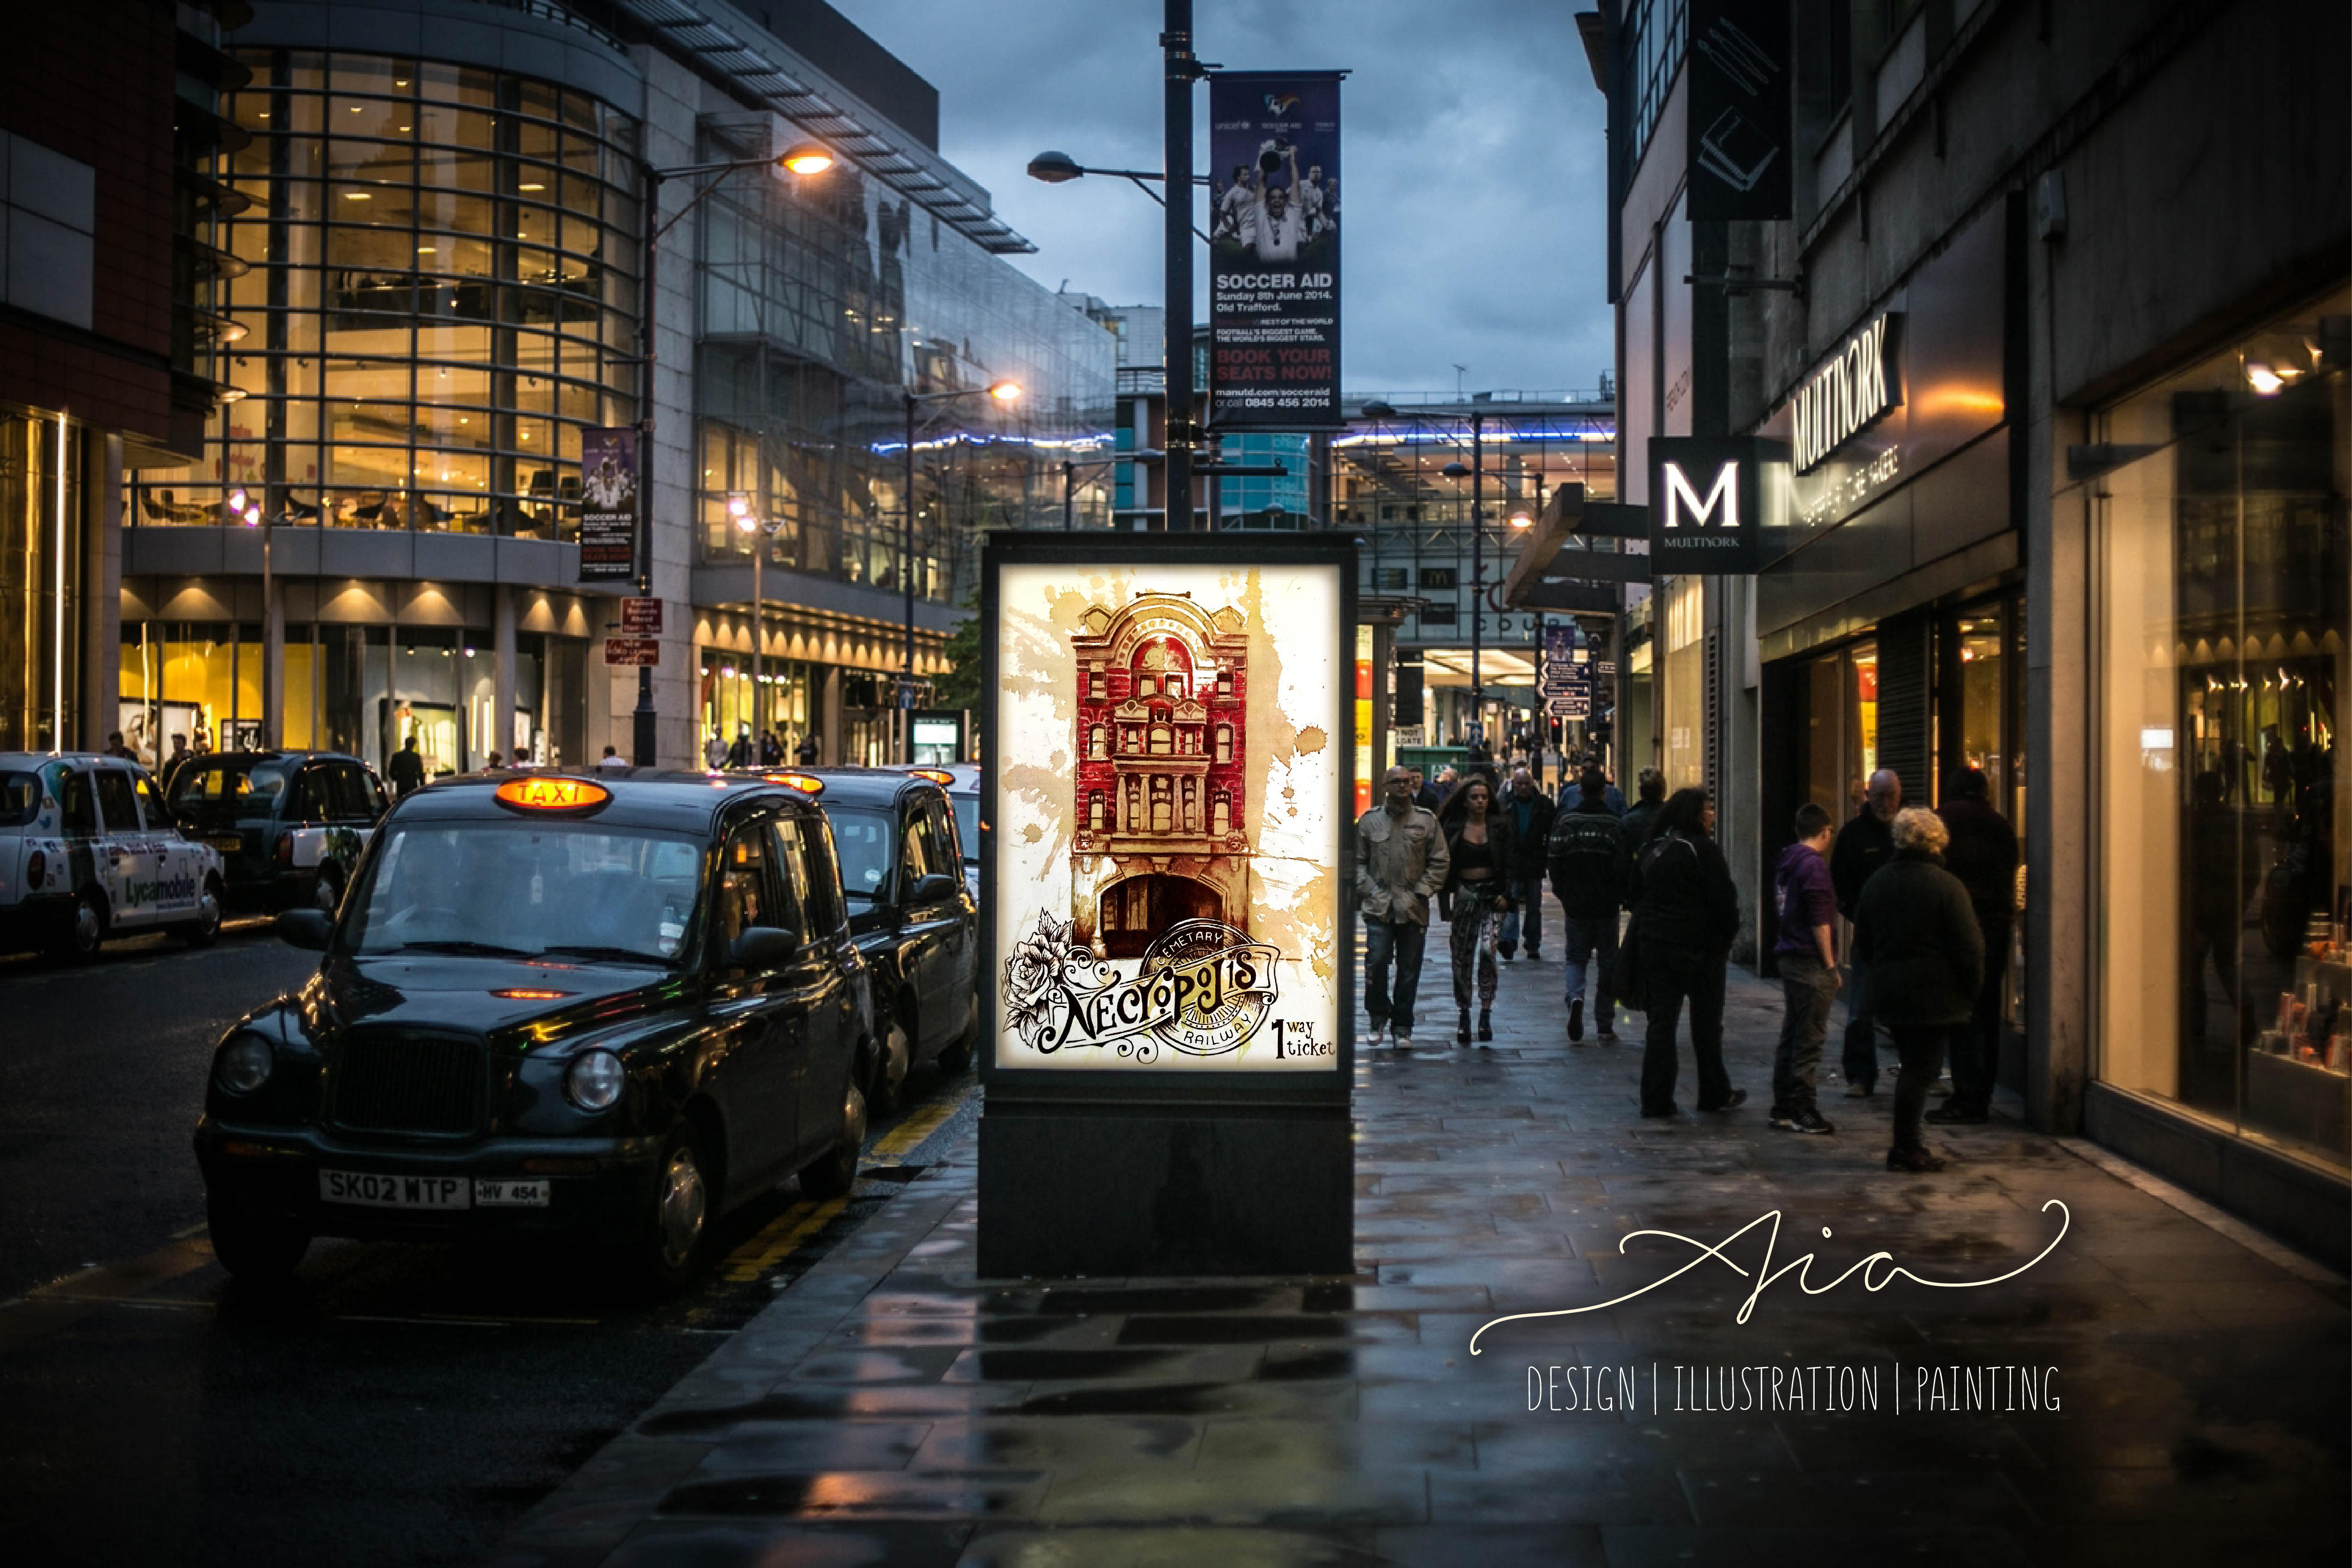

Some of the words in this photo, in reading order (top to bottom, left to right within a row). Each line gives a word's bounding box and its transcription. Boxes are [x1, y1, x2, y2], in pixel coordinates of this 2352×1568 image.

[1216, 274, 1295, 289] SOCCER
[1300, 273, 1333, 288] AID
[1216, 291, 1255, 302] Sunday
[1257, 292, 1274, 300] 8th
[1276, 292, 1302, 300] June
[1216, 303, 1234, 312] Old
[1237, 302, 1282, 312] Trafford.
[1217, 349, 1271, 364] BOOK
[1278, 348, 1330, 363] YOUR
[1217, 365, 1276, 380] SEATS
[1281, 365, 1331, 380] NOW!
[1245, 398, 1274, 408] 0845
[1277, 398, 1300, 408] 456
[1302, 398, 1330, 408] 2014
[1793, 314, 1887, 476] MULTIYORK
[1664, 462, 1740, 527] M
[1664, 536, 1740, 548] MULTIYORK
[517, 785, 580, 804] TAXI
[125, 873, 195, 908] Lycamobile
[1156, 931, 1223, 965] CEMETARY
[1184, 1013, 1252, 1046] RAILWAY
[1271, 1019, 1286, 1059] 1
[1287, 1020, 1315, 1039] way
[1287, 1037, 1336, 1057] ticket
[329, 1172, 397, 1201] SK02
